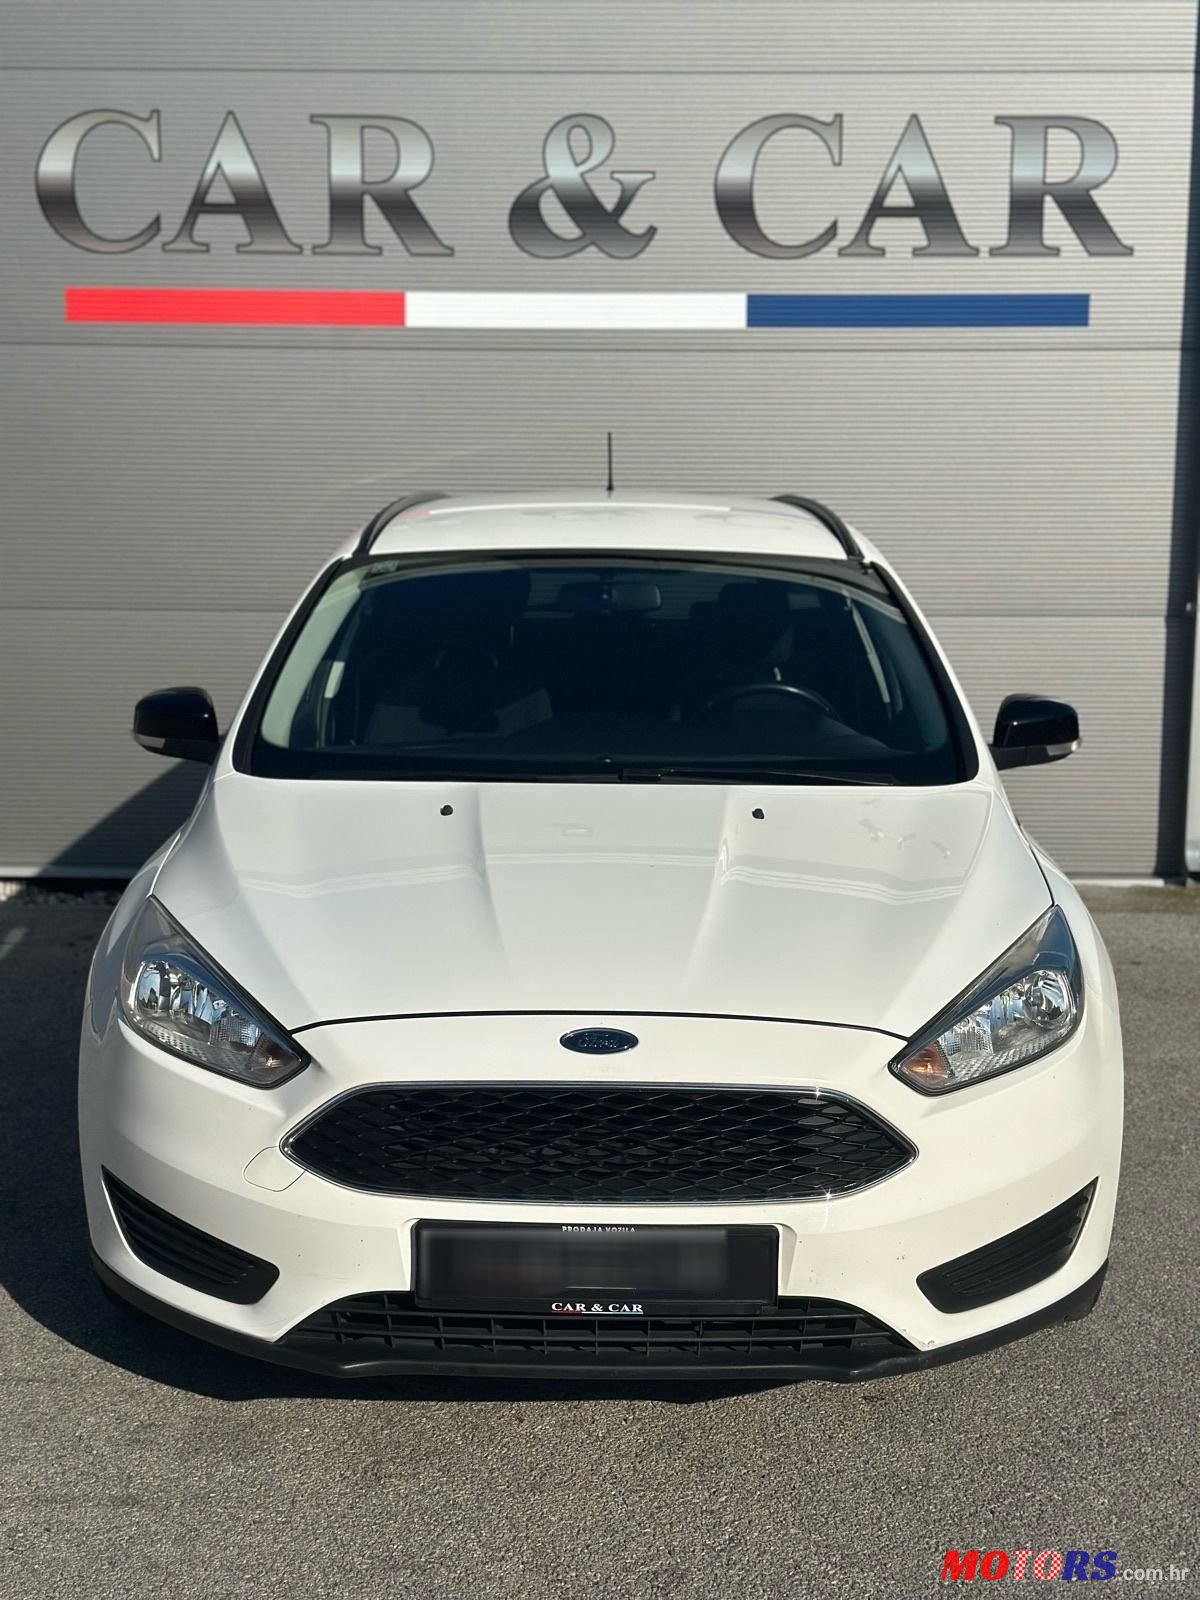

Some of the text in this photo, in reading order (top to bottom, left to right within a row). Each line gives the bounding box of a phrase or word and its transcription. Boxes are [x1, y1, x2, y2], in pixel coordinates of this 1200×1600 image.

[34, 108, 1134, 260] CAR & CAR
[561, 1225, 603, 1233] PRODAJA
[551, 1302, 644, 1312] CAR & CAR
